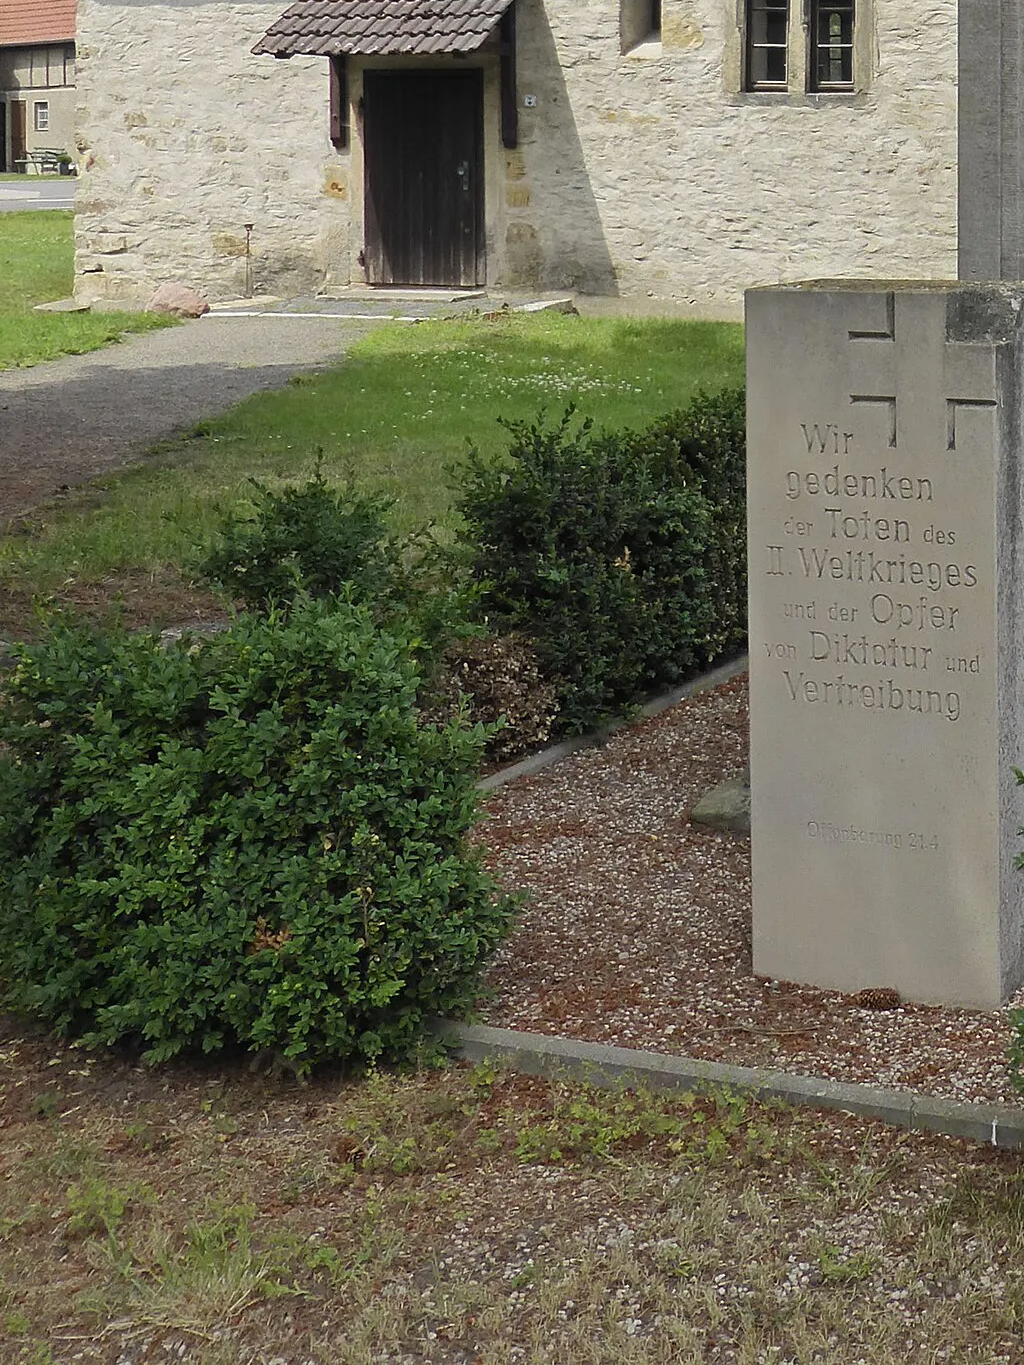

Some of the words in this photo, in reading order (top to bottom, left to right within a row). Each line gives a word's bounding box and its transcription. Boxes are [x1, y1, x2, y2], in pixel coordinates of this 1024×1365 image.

[800, 423, 853, 454] Wir
[786, 465, 933, 502] gedenken
[784, 516, 813, 536] der
[824, 508, 910, 543] Toten
[923, 525, 956, 545] des
[766, 545, 792, 576] II.
[798, 547, 978, 591] Weltkrieges
[784, 601, 816, 619] und
[828, 603, 858, 622] der
[871, 593, 960, 631] Opfer
[764, 642, 797, 659] von
[809, 630, 933, 670] Diktatur
[946, 655, 980, 674] und
[783, 671, 961, 721] Vertreibung
